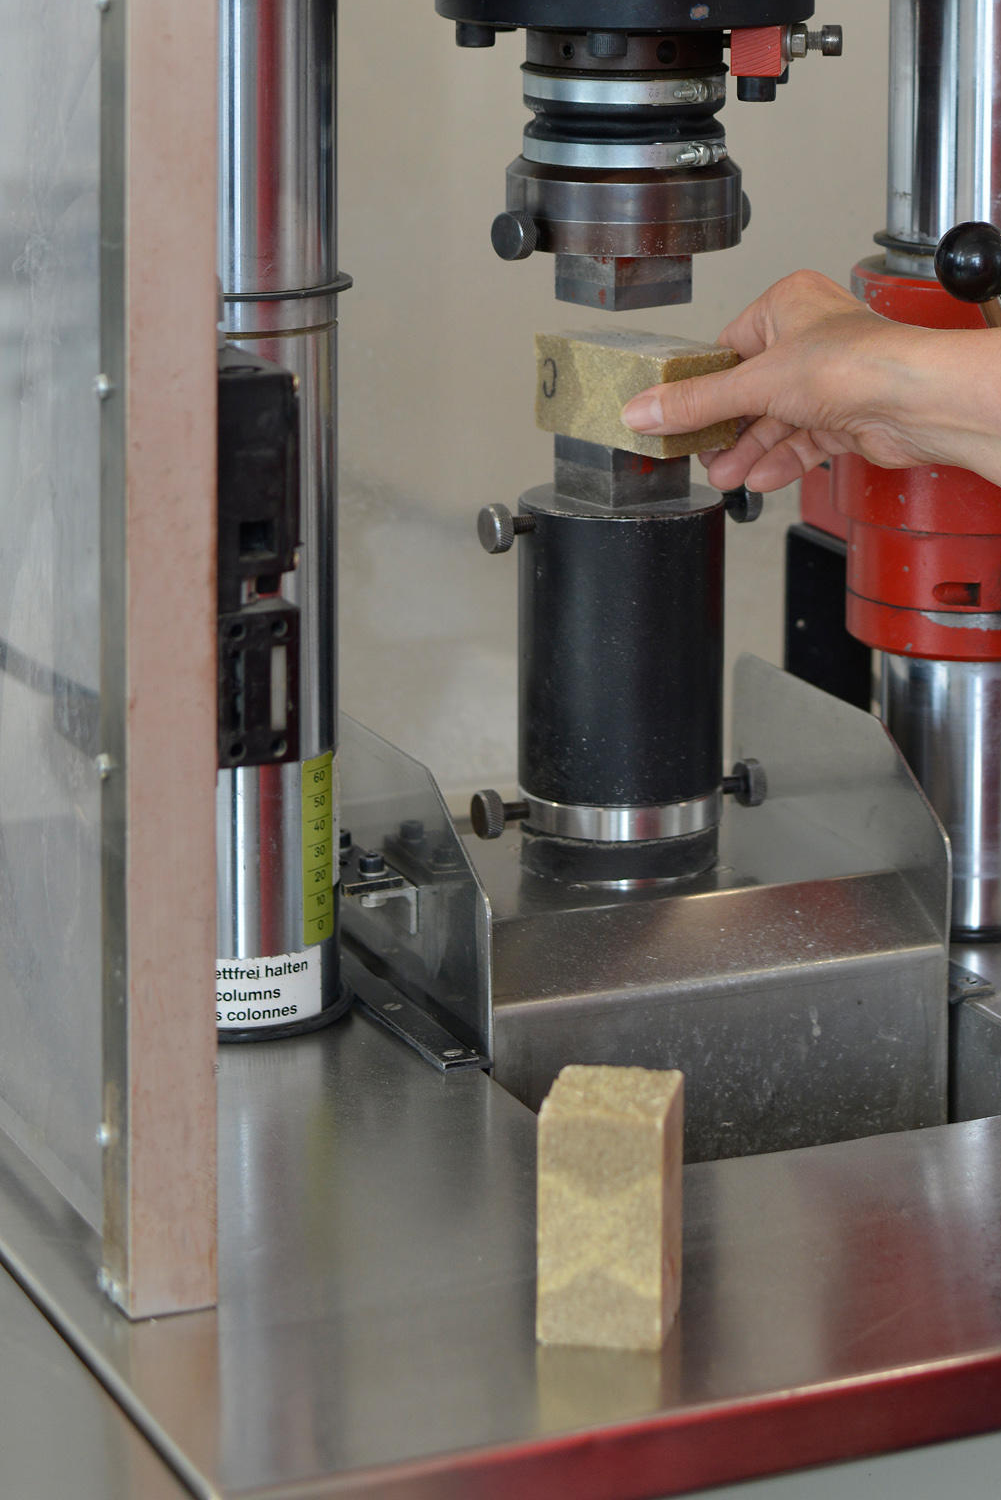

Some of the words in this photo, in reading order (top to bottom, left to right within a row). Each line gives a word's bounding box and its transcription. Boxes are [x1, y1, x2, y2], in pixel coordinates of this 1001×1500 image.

[313, 770, 325, 783] 60
[314, 795, 326, 808] 50
[314, 819, 325, 832] 40
[314, 844, 326, 858] 30
[314, 869, 326, 883] 20
[316, 894, 326, 907] 10
[317, 919, 324, 931] 0
[265, 960, 308, 978] halten
[216, 988, 281, 1002] columns
[227, 1004, 298, 1022] colonnes
